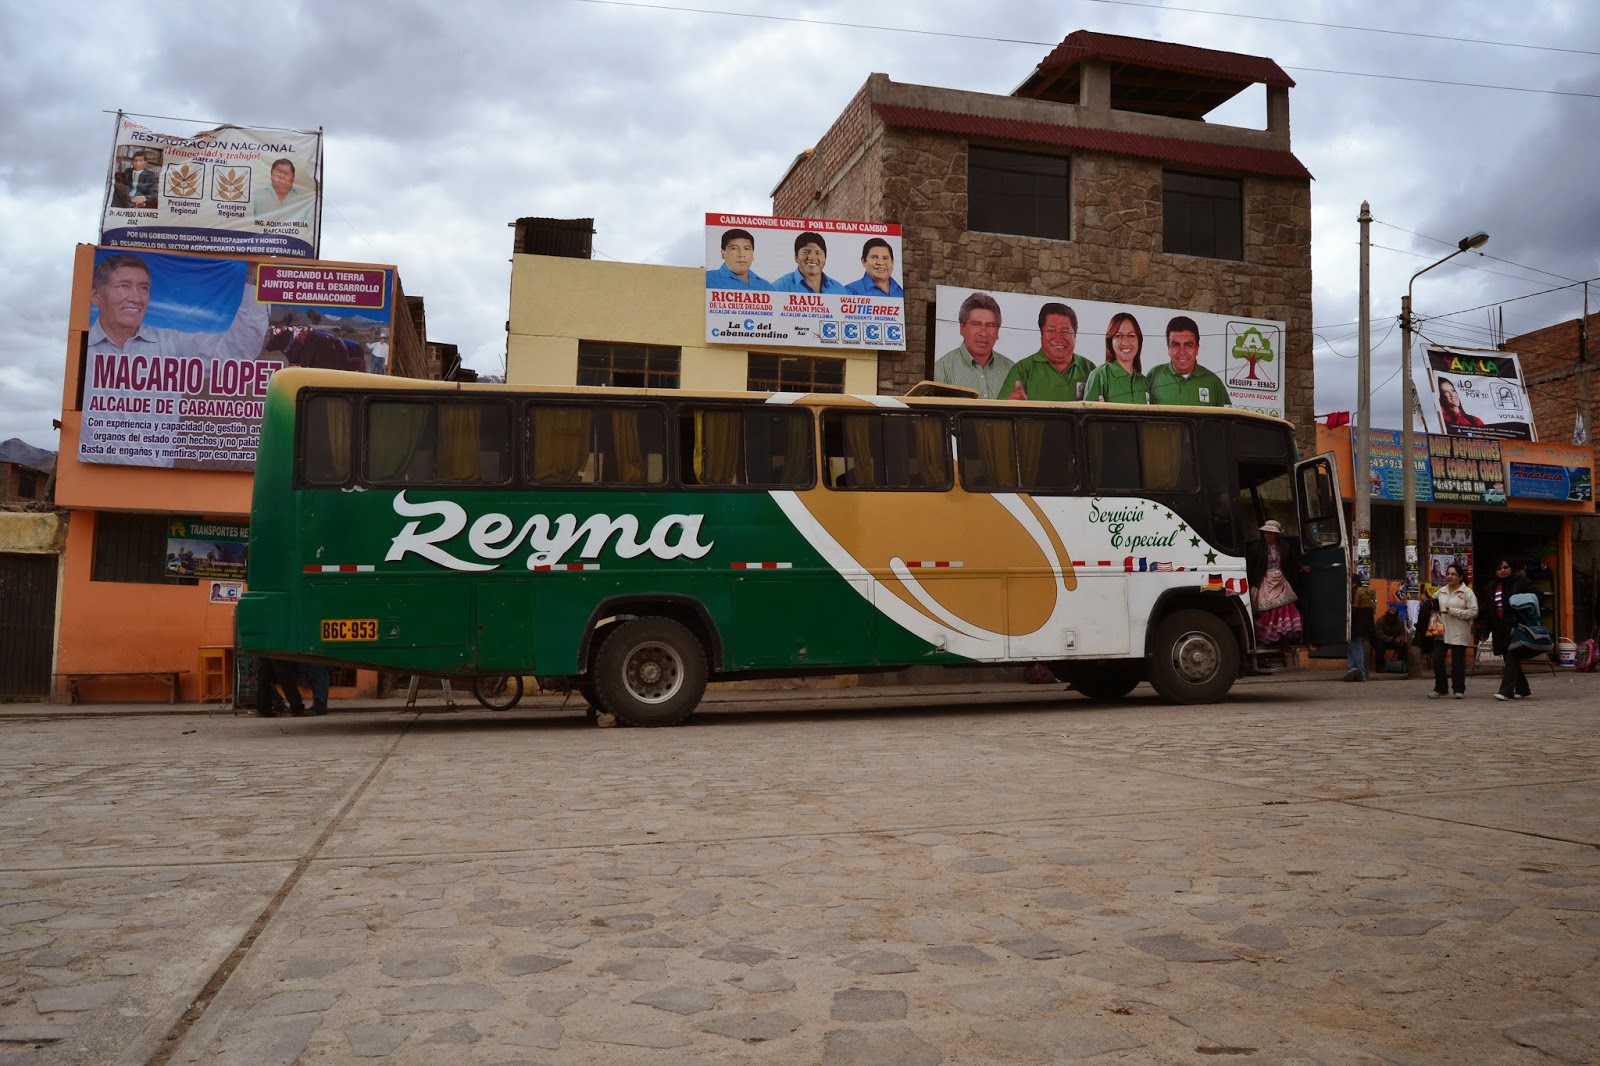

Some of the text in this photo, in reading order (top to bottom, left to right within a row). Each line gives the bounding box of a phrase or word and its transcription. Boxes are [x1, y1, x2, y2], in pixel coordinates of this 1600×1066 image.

[230, 142, 296, 152] NACIONAL
[226, 152, 261, 160] trabajo!
[168, 200, 200, 208] Presidente
[217, 203, 246, 211] Consejero
[170, 207, 198, 215] Regional
[218, 210, 245, 218] Regional
[720, 216, 778, 227] CABANACONDE
[780, 219, 805, 228] UNETE
[808, 221, 824, 229] POR
[836, 223, 858, 231] GRAN
[859, 224, 888, 233] CAMBIO
[120, 240, 156, 248] DESARROLLO
[148, 232, 178, 240] GOBIERNO
[180, 234, 209, 242] REGIONAL
[210, 236, 254, 244] TRANSPARENTE
[276, 269, 365, 282] SURCANDO LA TIERRA
[262, 280, 380, 293] JUNTOS POR EL DESARROLLO
[282, 292, 356, 303] DE CABANACONDE
[712, 291, 770, 304] RICHARD
[789, 294, 824, 306] RAUL
[783, 305, 810, 313] MAMANI
[840, 304, 900, 316] GUTIERREZ
[744, 318, 754, 330] C
[712, 328, 788, 339] Cabanacondino
[822, 323, 837, 338] C
[844, 324, 858, 339] C
[866, 325, 879, 340] C
[887, 326, 901, 340] C
[93, 354, 204, 394] MACARIO
[1229, 378, 1276, 389] AREQUIPA RENACE
[1229, 391, 1256, 399] AREQUIPA
[89, 396, 263, 418] ALCALDE DE CABANACON
[88, 417, 104, 427] Con
[106, 419, 152, 430] experiencia
[154, 423, 159, 432] y
[161, 420, 203, 433] capacidad
[204, 422, 215, 432] de
[217, 423, 246, 434] gestión
[93, 430, 126, 444] órganos
[128, 432, 140, 442] del
[143, 433, 170, 444] estado
[172, 436, 187, 444] con
[189, 436, 217, 446] hechos
[218, 439, 223, 448] y
[226, 438, 236, 446] no
[81, 443, 104, 454] Basta
[106, 445, 116, 454] de
[119, 445, 153, 458] engaños
[155, 450, 160, 458] y
[162, 448, 197, 459] mentiras
[198, 451, 211, 461] por
[231, 451, 256, 460] marca
[1414, 446, 1429, 460] UNO
[1452, 437, 1500, 461] DEPARTURES
[1414, 461, 1426, 470] AM
[1474, 481, 1486, 492] AM
[1088, 497, 1145, 523] Servicio
[190, 525, 238, 537] TRANSPORTES
[384, 490, 714, 571] Reyna
[1108, 523, 1178, 553] Especial
